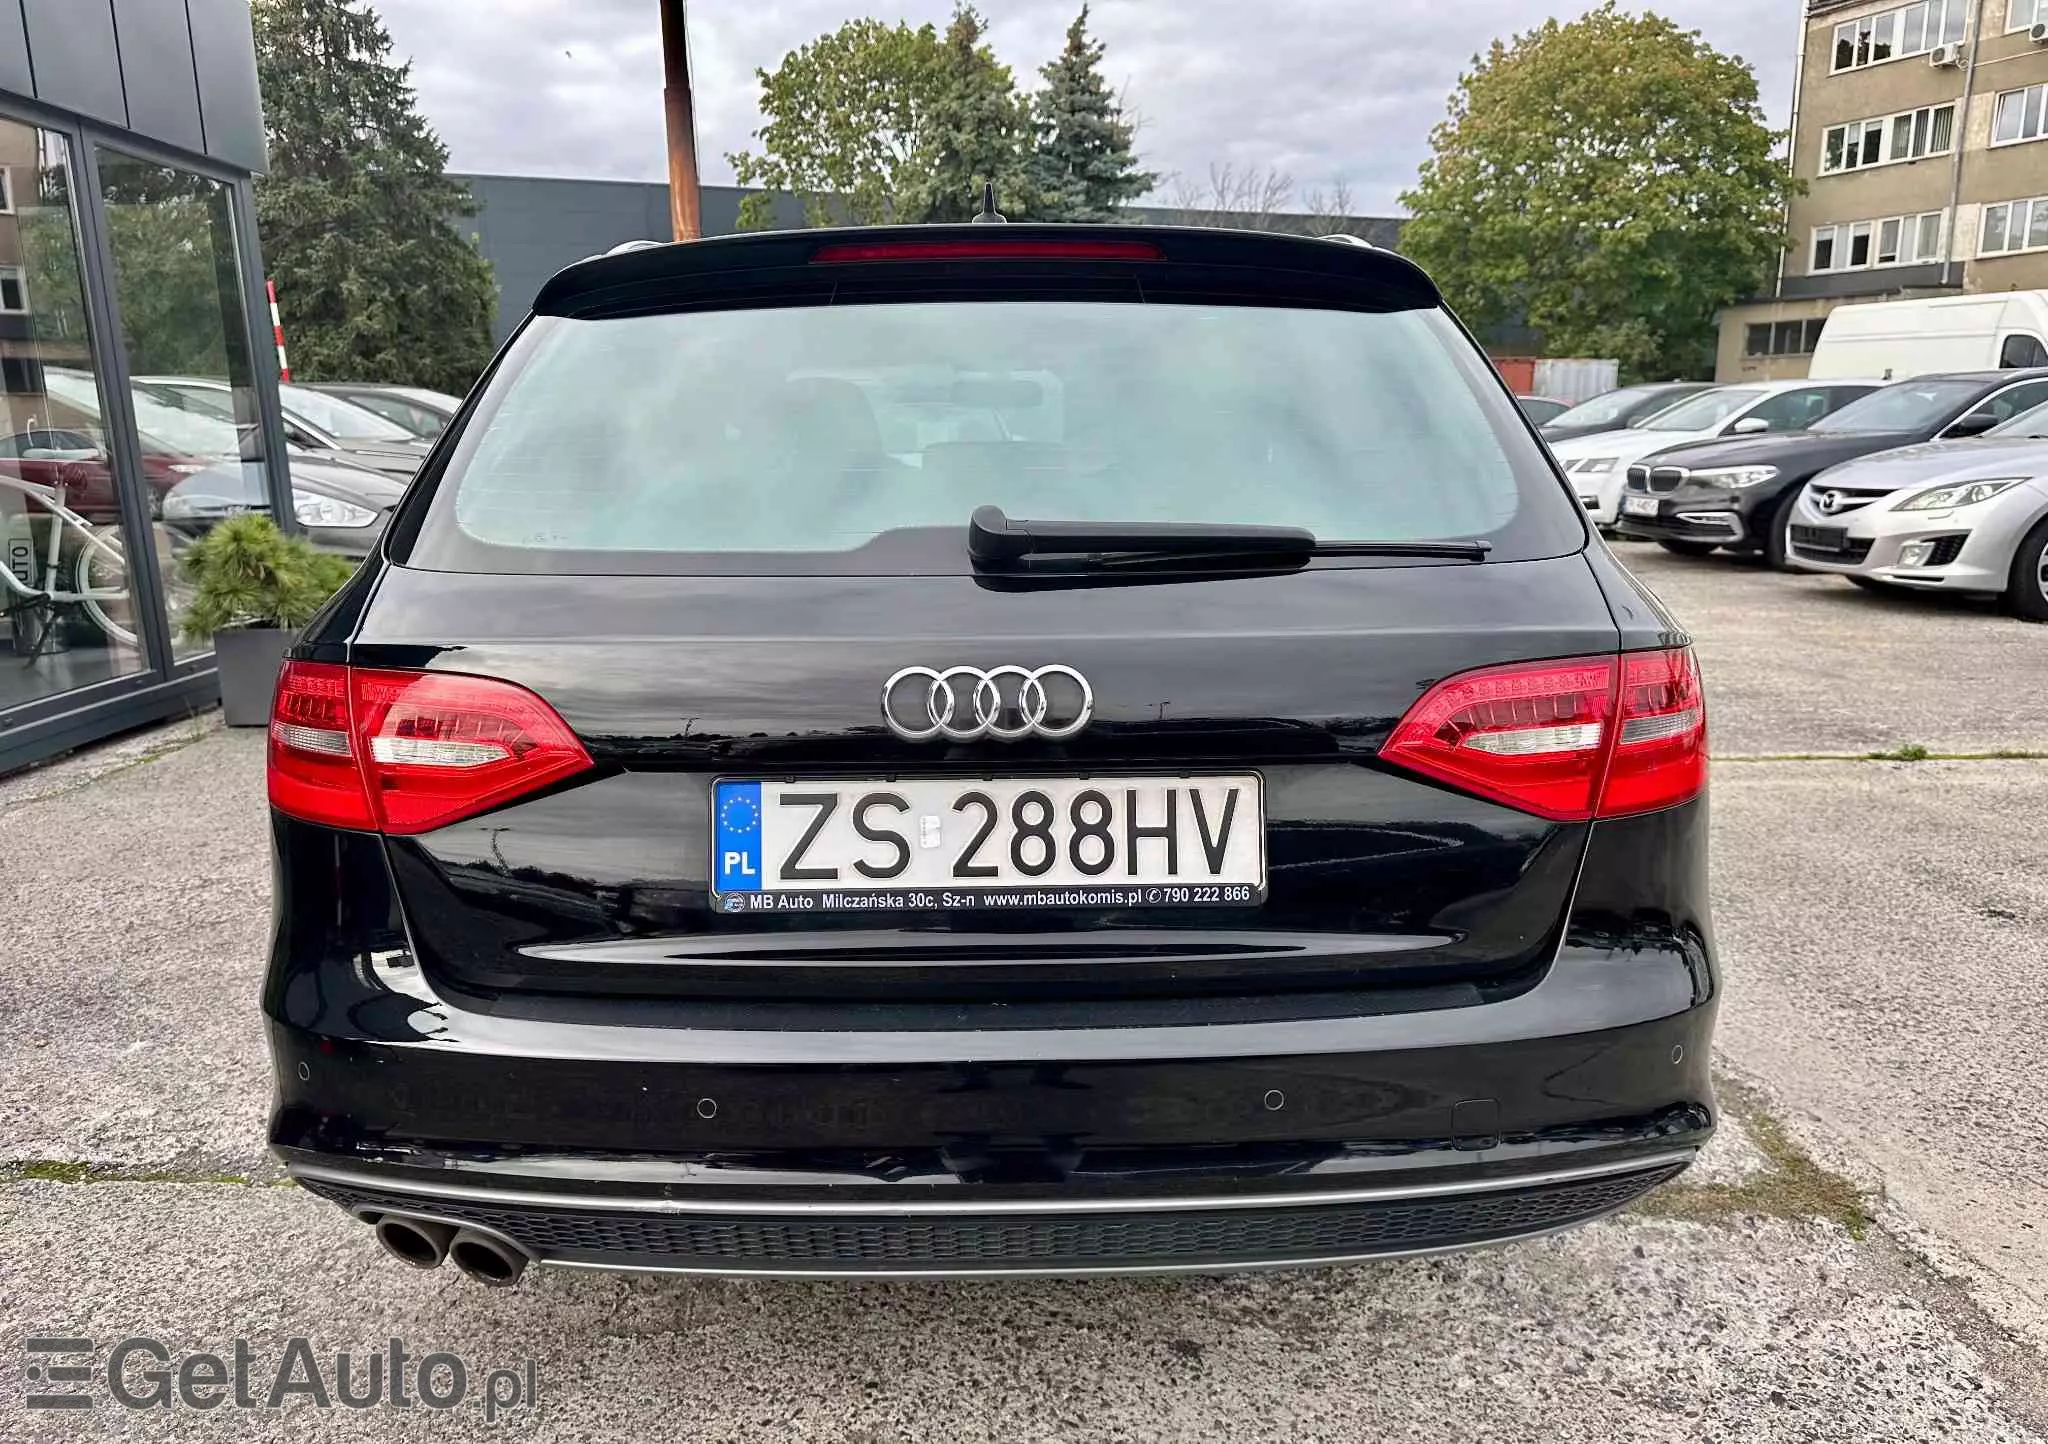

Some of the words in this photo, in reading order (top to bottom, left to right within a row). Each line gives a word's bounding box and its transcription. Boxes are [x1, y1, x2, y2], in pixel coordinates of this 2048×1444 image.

[12, 547, 28, 584] UTO
[779, 792, 911, 879] ZS
[952, 788, 1240, 878] 288HV
[724, 852, 756, 875] PL
[750, 894, 774, 909] MB
[777, 894, 814, 909] Auto
[822, 892, 904, 908] Milczańska
[908, 893, 938, 909] 30c,
[942, 892, 976, 907] Sz-n
[984, 889, 1142, 907] www.mbautokomis.pl
[1163, 889, 1189, 902] 790
[1193, 888, 1220, 902] 222
[1224, 886, 1250, 900] 866
